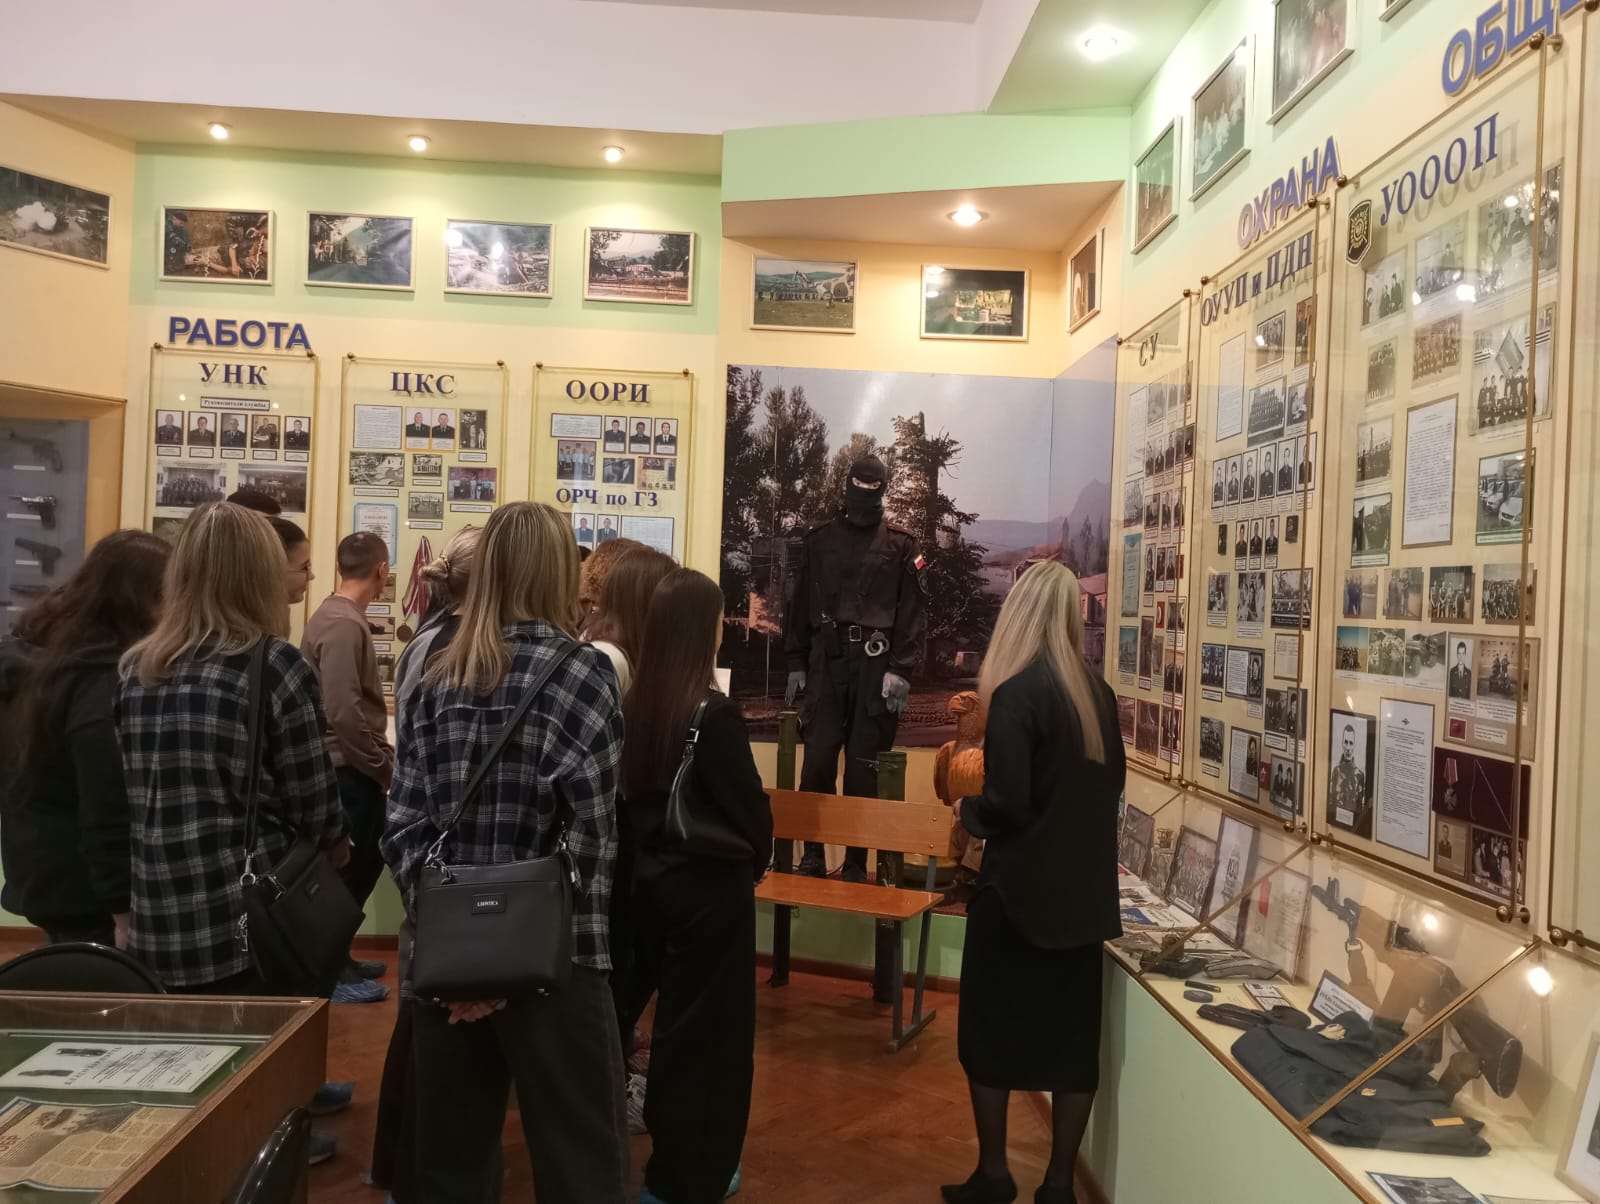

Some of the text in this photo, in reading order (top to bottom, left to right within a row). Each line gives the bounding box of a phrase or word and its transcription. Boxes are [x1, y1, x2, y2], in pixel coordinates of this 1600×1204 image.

[1442, 0, 1583, 96] ОБЩ
[1380, 112, 1499, 226] УОООП
[1237, 135, 1340, 249] ОХРАНА
[1201, 230, 1314, 327] ОУУП и ПДН
[169, 316, 312, 350] РАБОТА
[1139, 332, 1159, 367] СУ
[199, 362, 267, 386] УНК
[391, 371, 456, 397] ЦКС
[566, 379, 651, 404] ООРИ
[556, 488, 659, 507] ОРЧ по ГЗ
